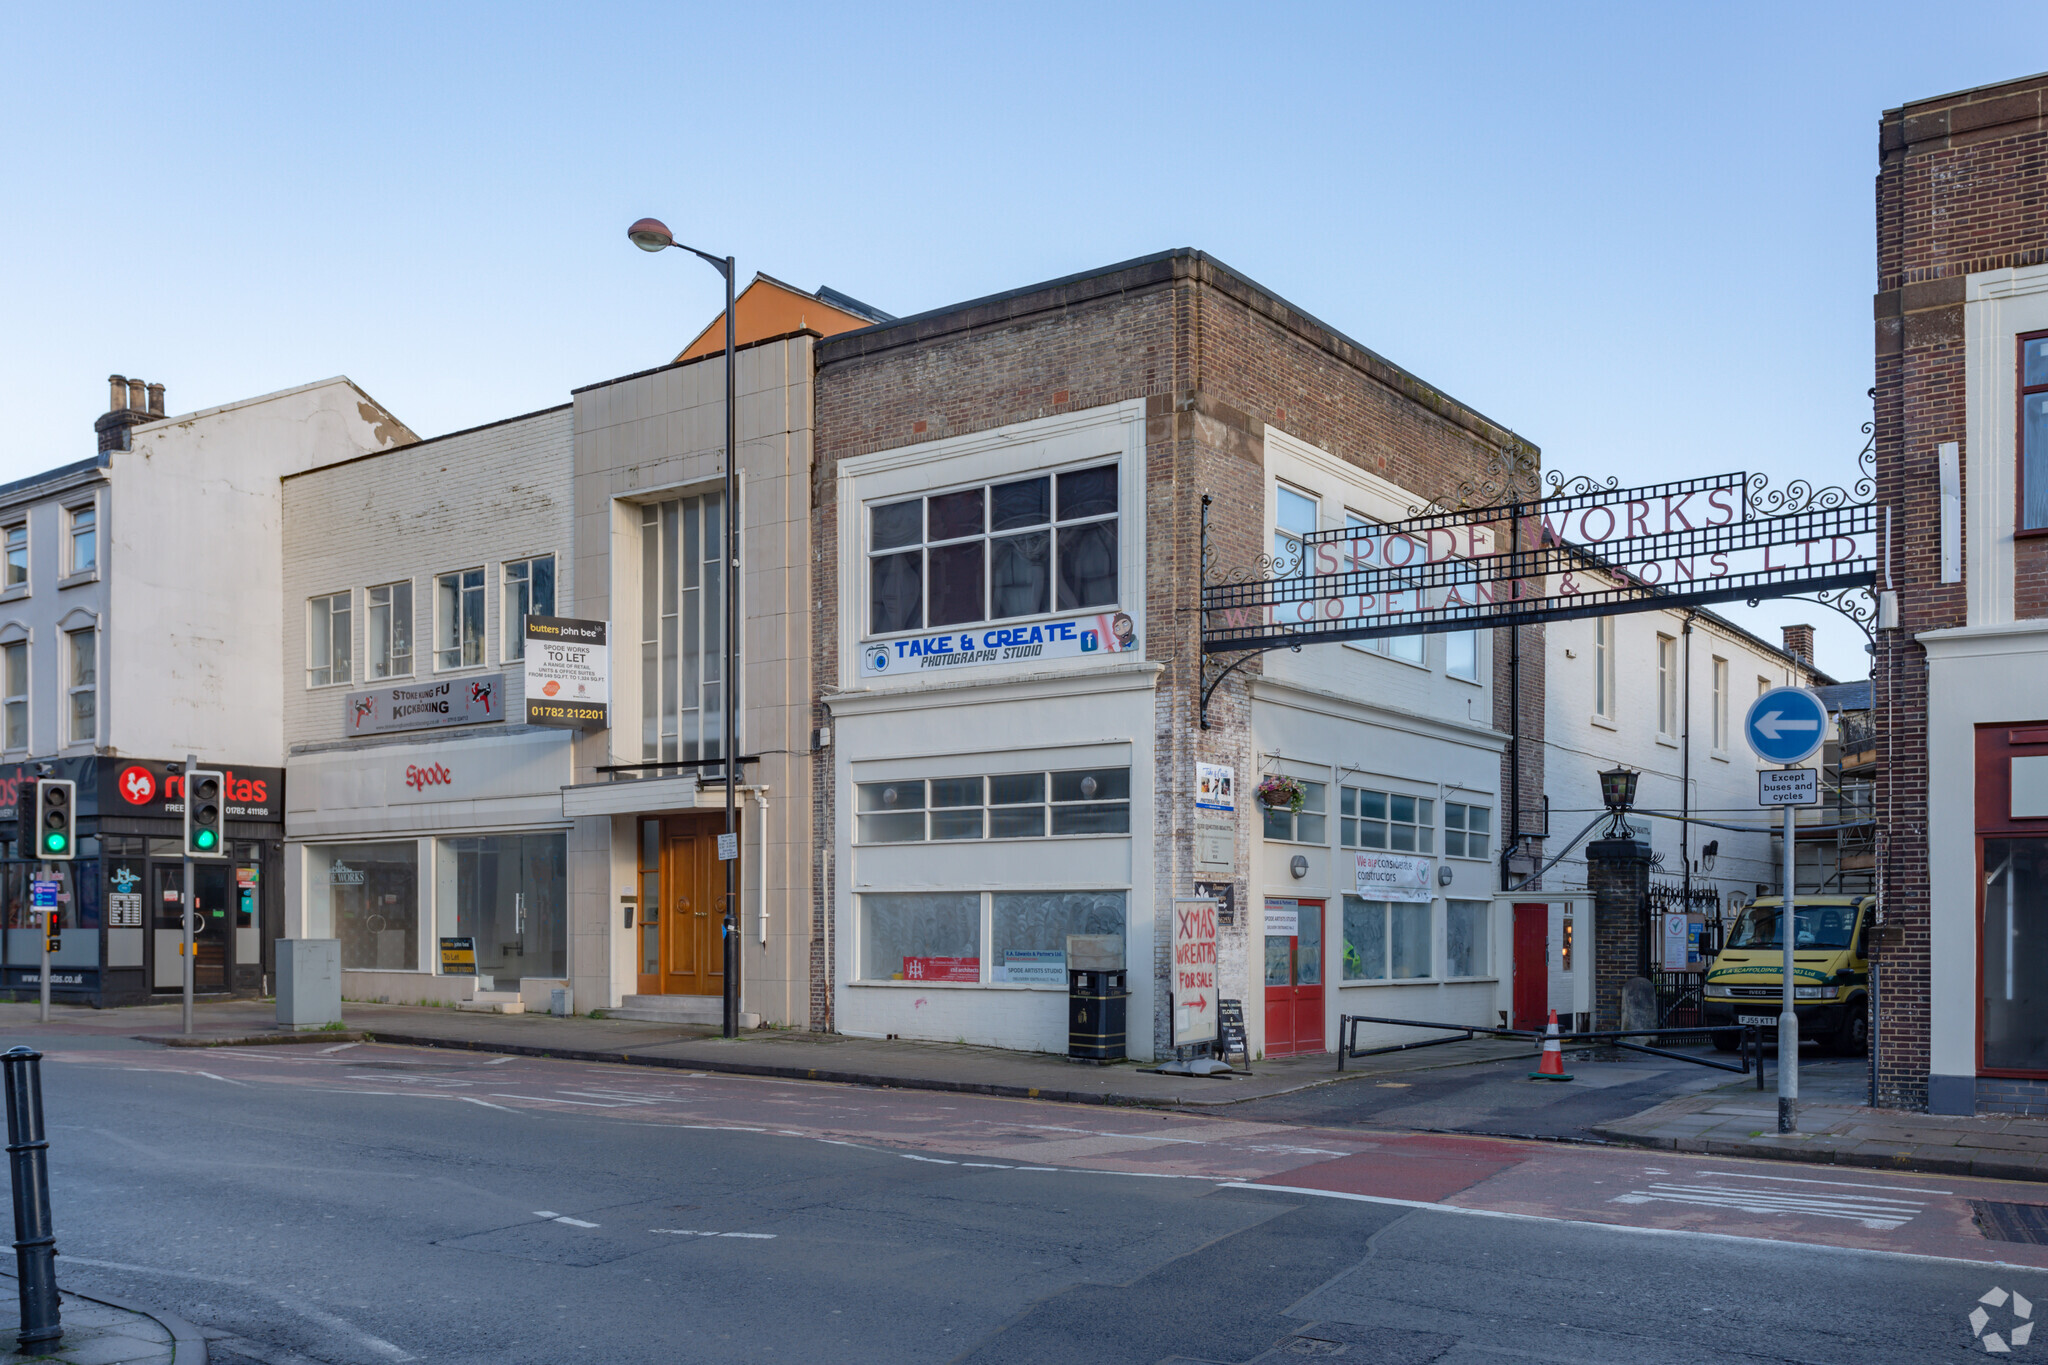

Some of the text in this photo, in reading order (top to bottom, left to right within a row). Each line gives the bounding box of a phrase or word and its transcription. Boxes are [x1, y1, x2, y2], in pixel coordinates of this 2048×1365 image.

[1316, 486, 1734, 575] SPODE WORKS
[1296, 579, 1528, 622] COPELAND
[1559, 572, 1581, 596] &
[1611, 552, 1729, 591] SONS
[530, 624, 560, 634] butters
[560, 626, 579, 636] john
[580, 628, 597, 638] bee
[895, 636, 954, 658] TAKE
[960, 634, 975, 651] &
[983, 622, 1077, 648] CREATE
[543, 644, 566, 652] SPODE
[548, 651, 586, 663] TO LET
[920, 644, 1043, 668] PHOTOGRAPHY STUDIO
[392, 683, 450, 701] STOKE KUNG FU
[392, 701, 450, 720] KICKBOXING
[531, 706, 604, 719] 01782 212201
[406, 761, 451, 792] Spode
[1771, 773, 1805, 782] Except
[1795, 782, 1813, 790] and
[1773, 792, 1804, 801] cycles
[226, 807, 269, 816] 01782 411186
[1356, 855, 1367, 867] We
[340, 871, 364, 882] WORKS
[1357, 869, 1397, 882] constructors
[1178, 908, 1216, 939] XMAS
[1180, 971, 1213, 991] FOR SALE
[1741, 1016, 1774, 1025] FJ55 KTT
